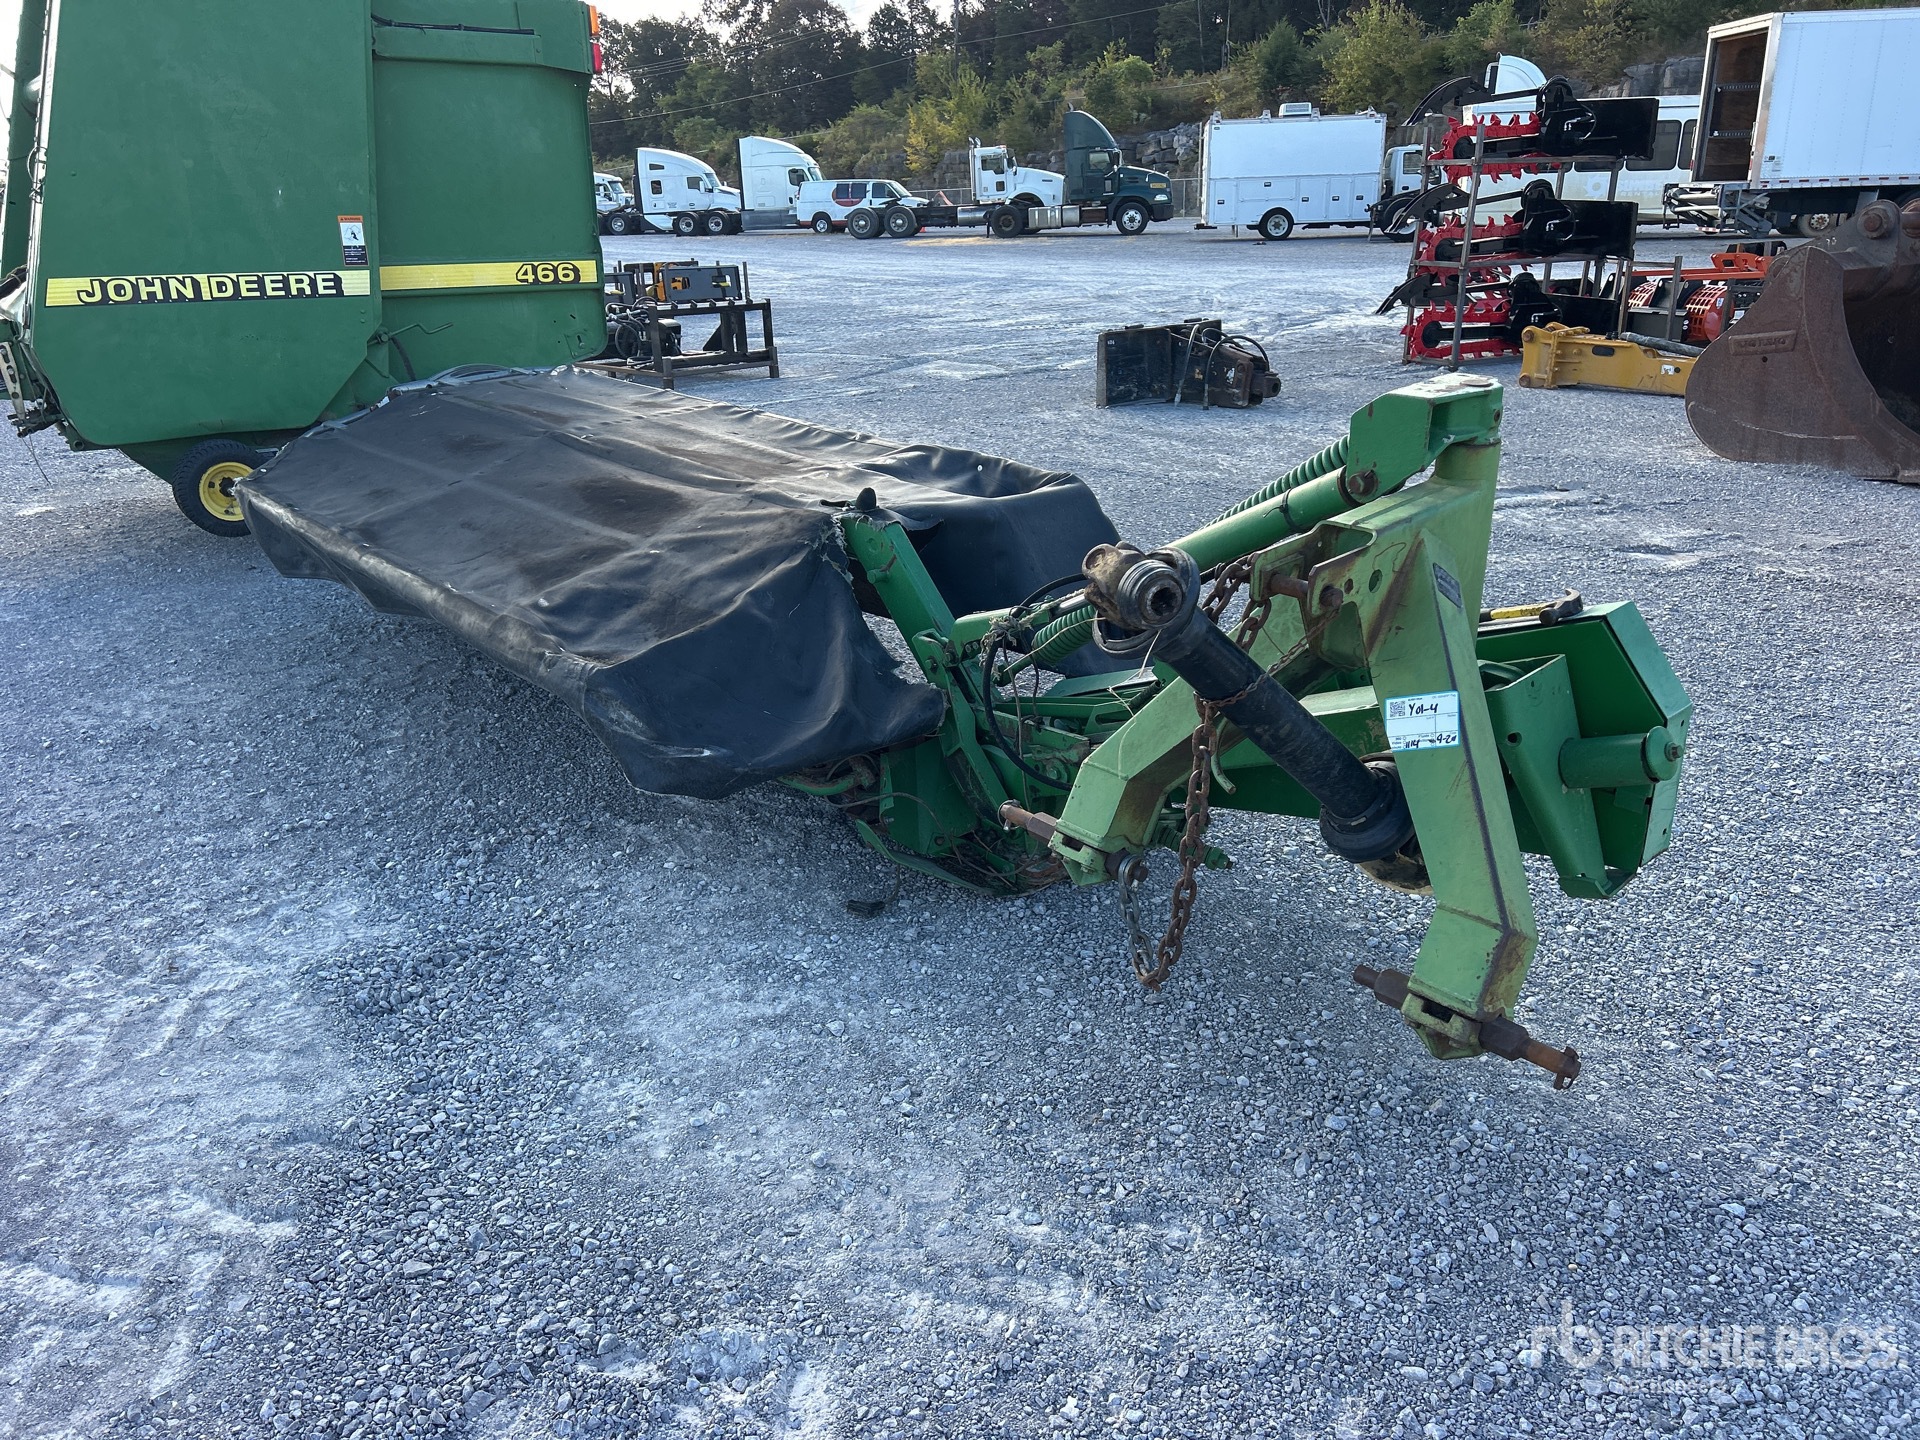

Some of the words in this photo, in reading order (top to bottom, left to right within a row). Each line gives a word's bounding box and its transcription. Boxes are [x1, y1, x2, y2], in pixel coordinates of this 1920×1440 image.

[516, 262, 580, 284] 466
[77, 276, 203, 305] JOHN
[207, 272, 341, 299] DEERE
